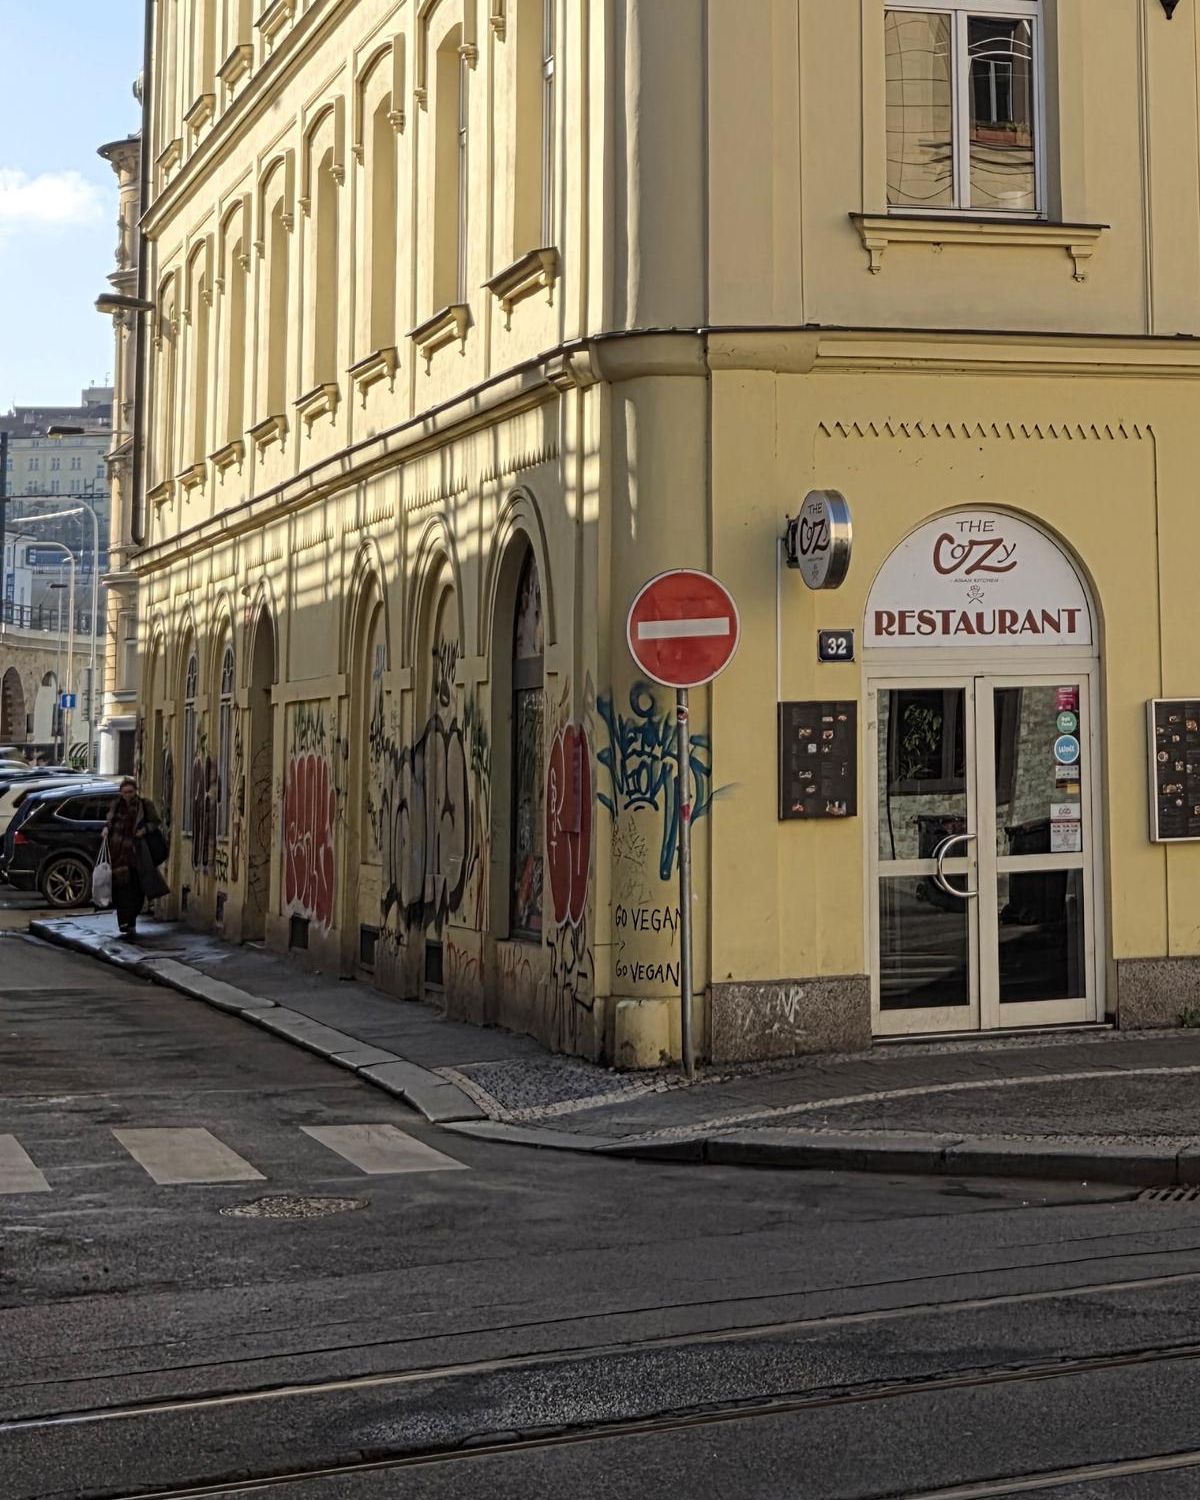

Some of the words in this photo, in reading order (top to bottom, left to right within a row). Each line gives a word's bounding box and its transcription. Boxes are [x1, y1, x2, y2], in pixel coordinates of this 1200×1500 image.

[808, 502, 822, 515] THE
[955, 520, 996, 532] THE
[874, 608, 1081, 636] RESTAURANT
[827, 637, 847, 655] 32
[615, 904, 628, 927] GO
[630, 961, 680, 987] VEGAN
